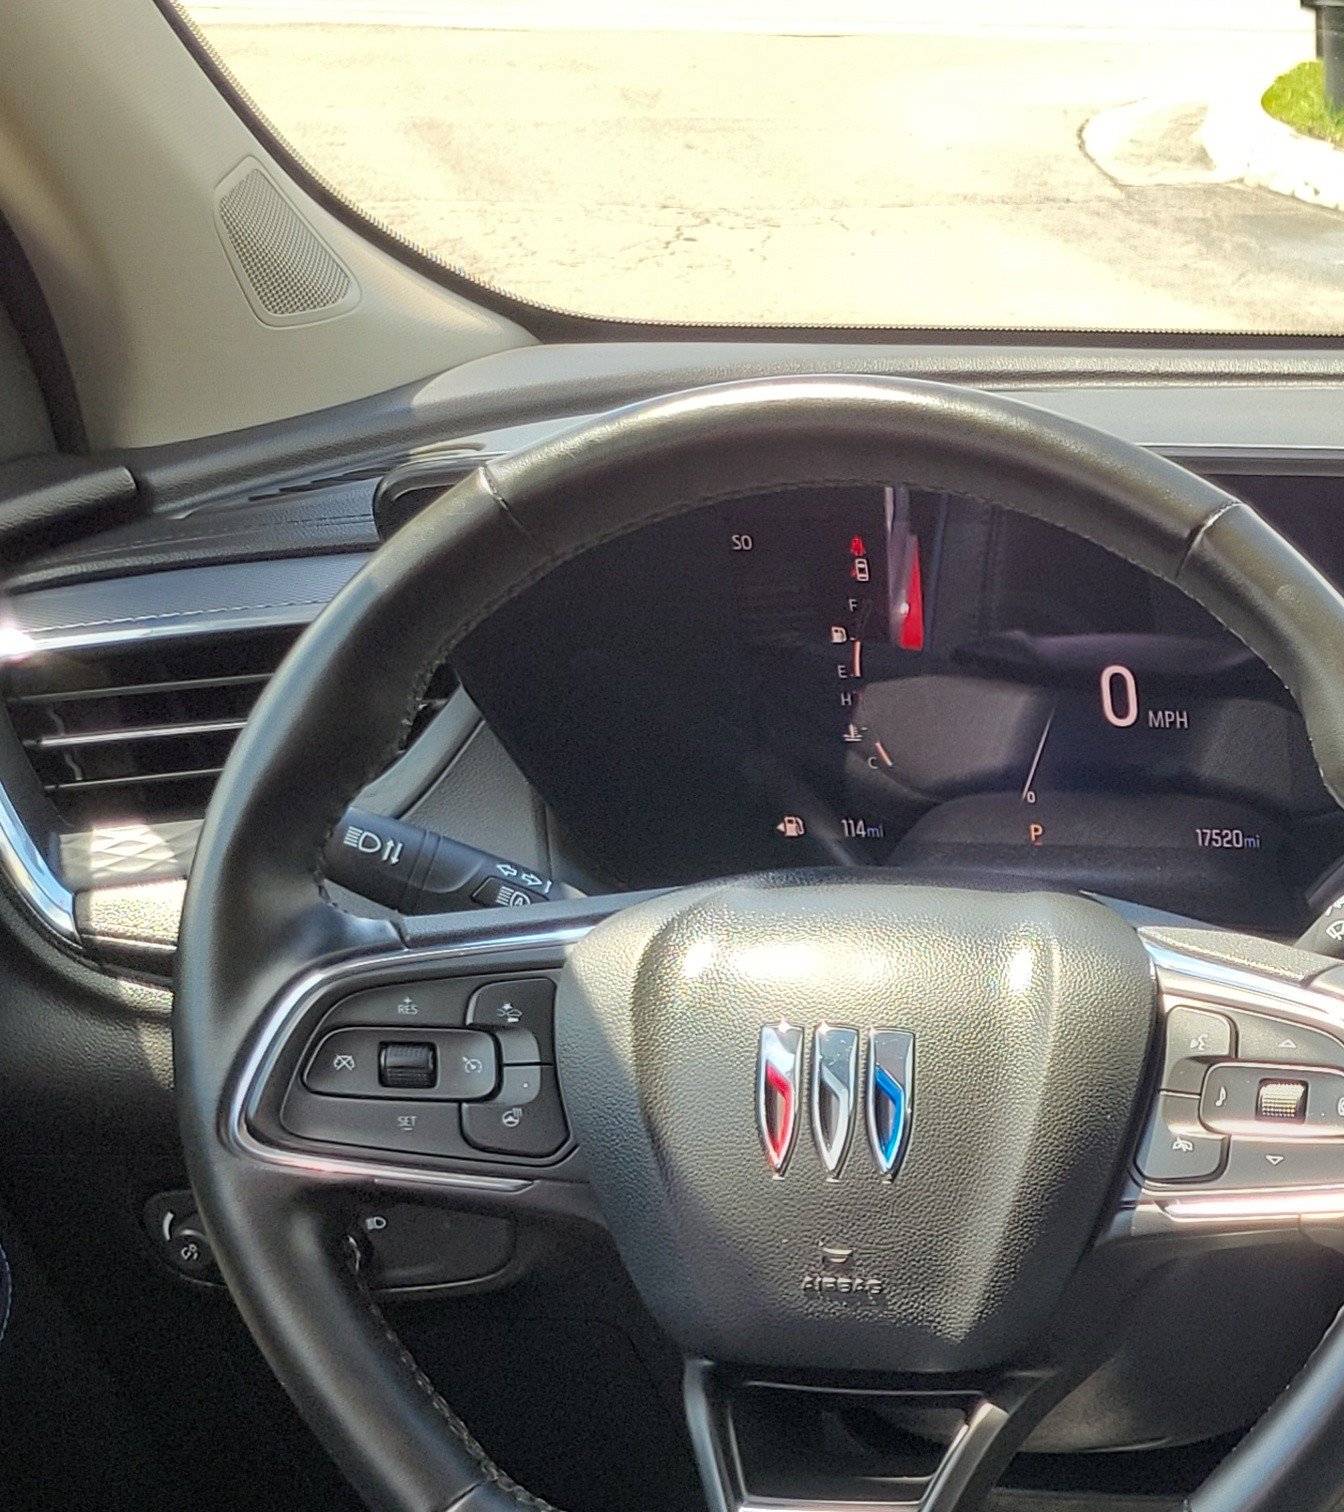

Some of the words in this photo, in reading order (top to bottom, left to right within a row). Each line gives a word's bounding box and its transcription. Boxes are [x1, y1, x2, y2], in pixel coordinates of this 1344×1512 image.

[849, 599, 858, 612] F
[838, 665, 848, 678] E
[841, 693, 852, 706] H
[1101, 665, 1138, 727] 0
[1148, 710, 1189, 729] MPH
[868, 756, 878, 769] C
[1030, 823, 1043, 841] P
[397, 1004, 419, 1015] RES
[397, 1115, 417, 1127] SET
[802, 1276, 882, 1294] AIRBAG
